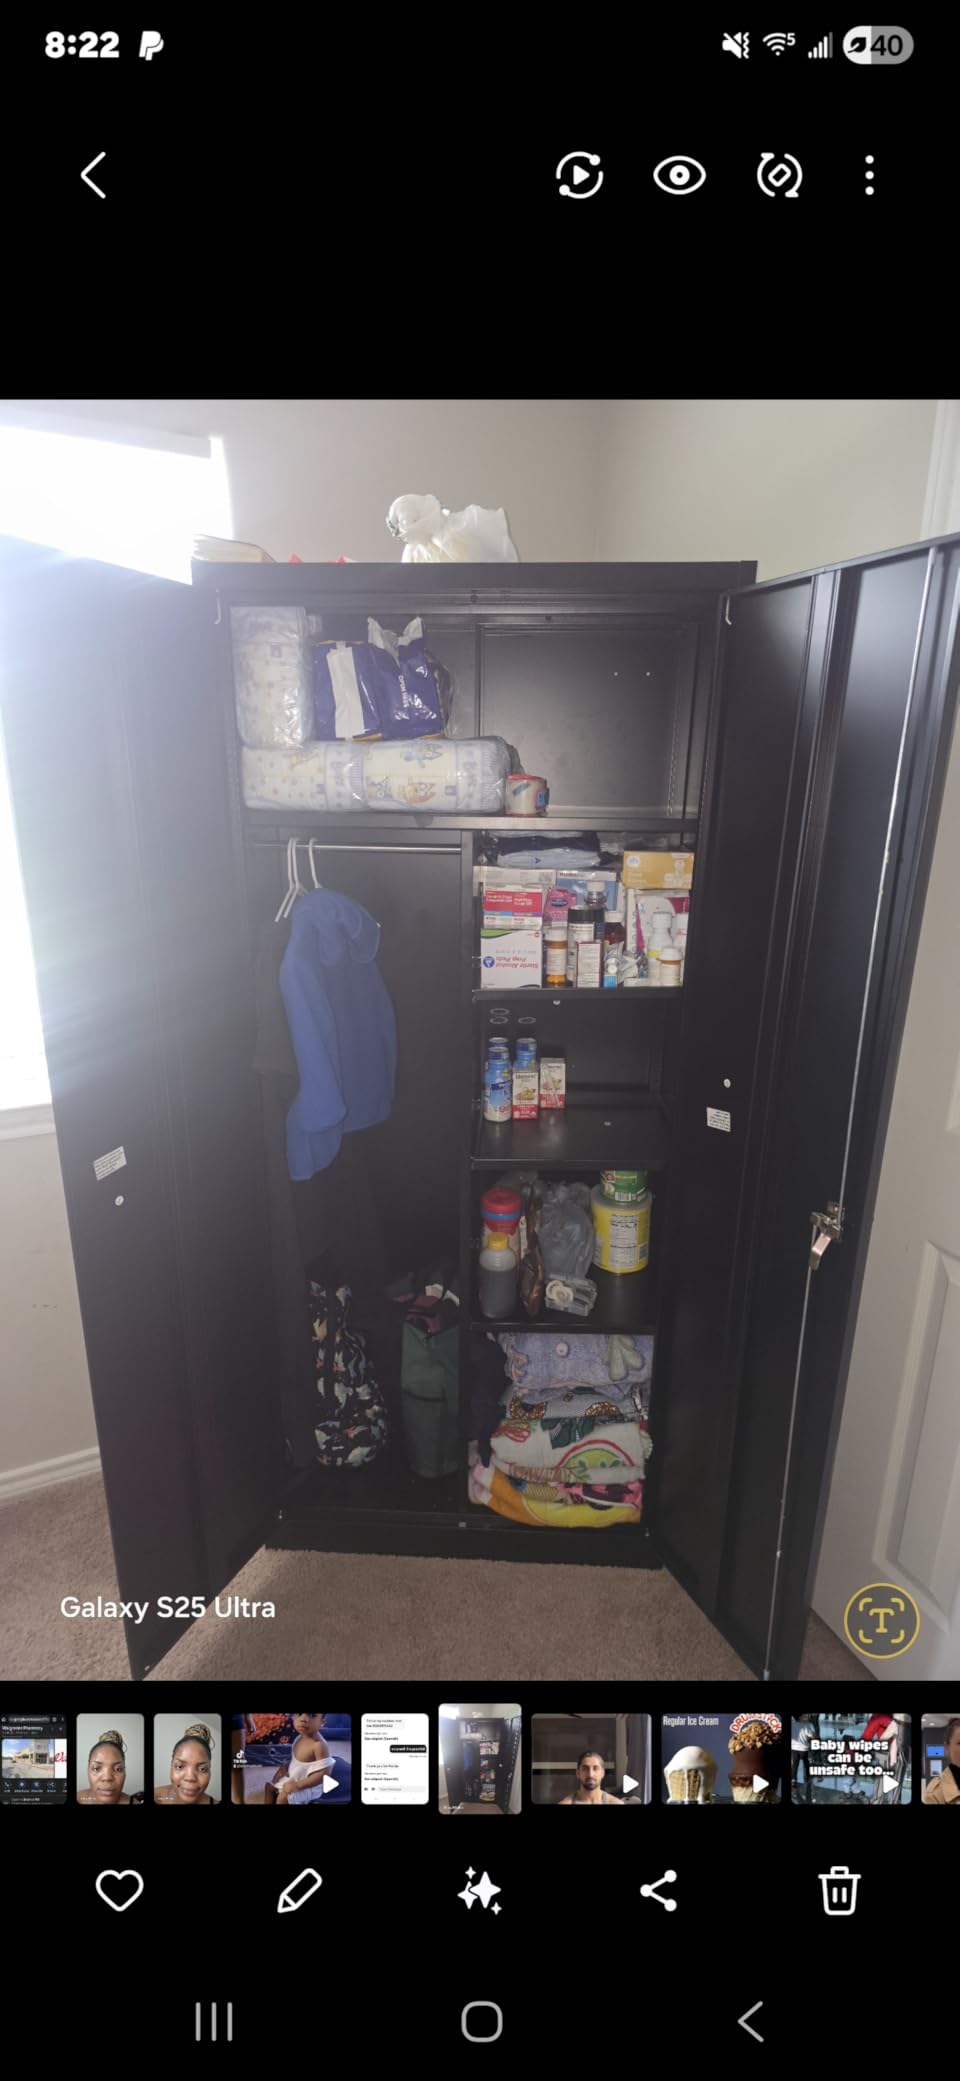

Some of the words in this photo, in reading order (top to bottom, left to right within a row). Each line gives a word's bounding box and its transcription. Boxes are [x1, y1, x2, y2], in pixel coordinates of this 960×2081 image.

[45, 30, 120, 59] 8:22
[870, 34, 904, 57] 40
[399, 675, 407, 692] OPEN
[663, 1716, 686, 1727] Regular
[688, 1716, 697, 1726] Ice
[698, 1716, 720, 1726] Cream
[810, 1739, 845, 1753] Baby
[849, 1740, 889, 1752] wipes
[827, 1753, 851, 1763] can
[854, 1752, 872, 1763] be
[809, 1764, 855, 1775] unsafe
[858, 1764, 894, 1775] too...
